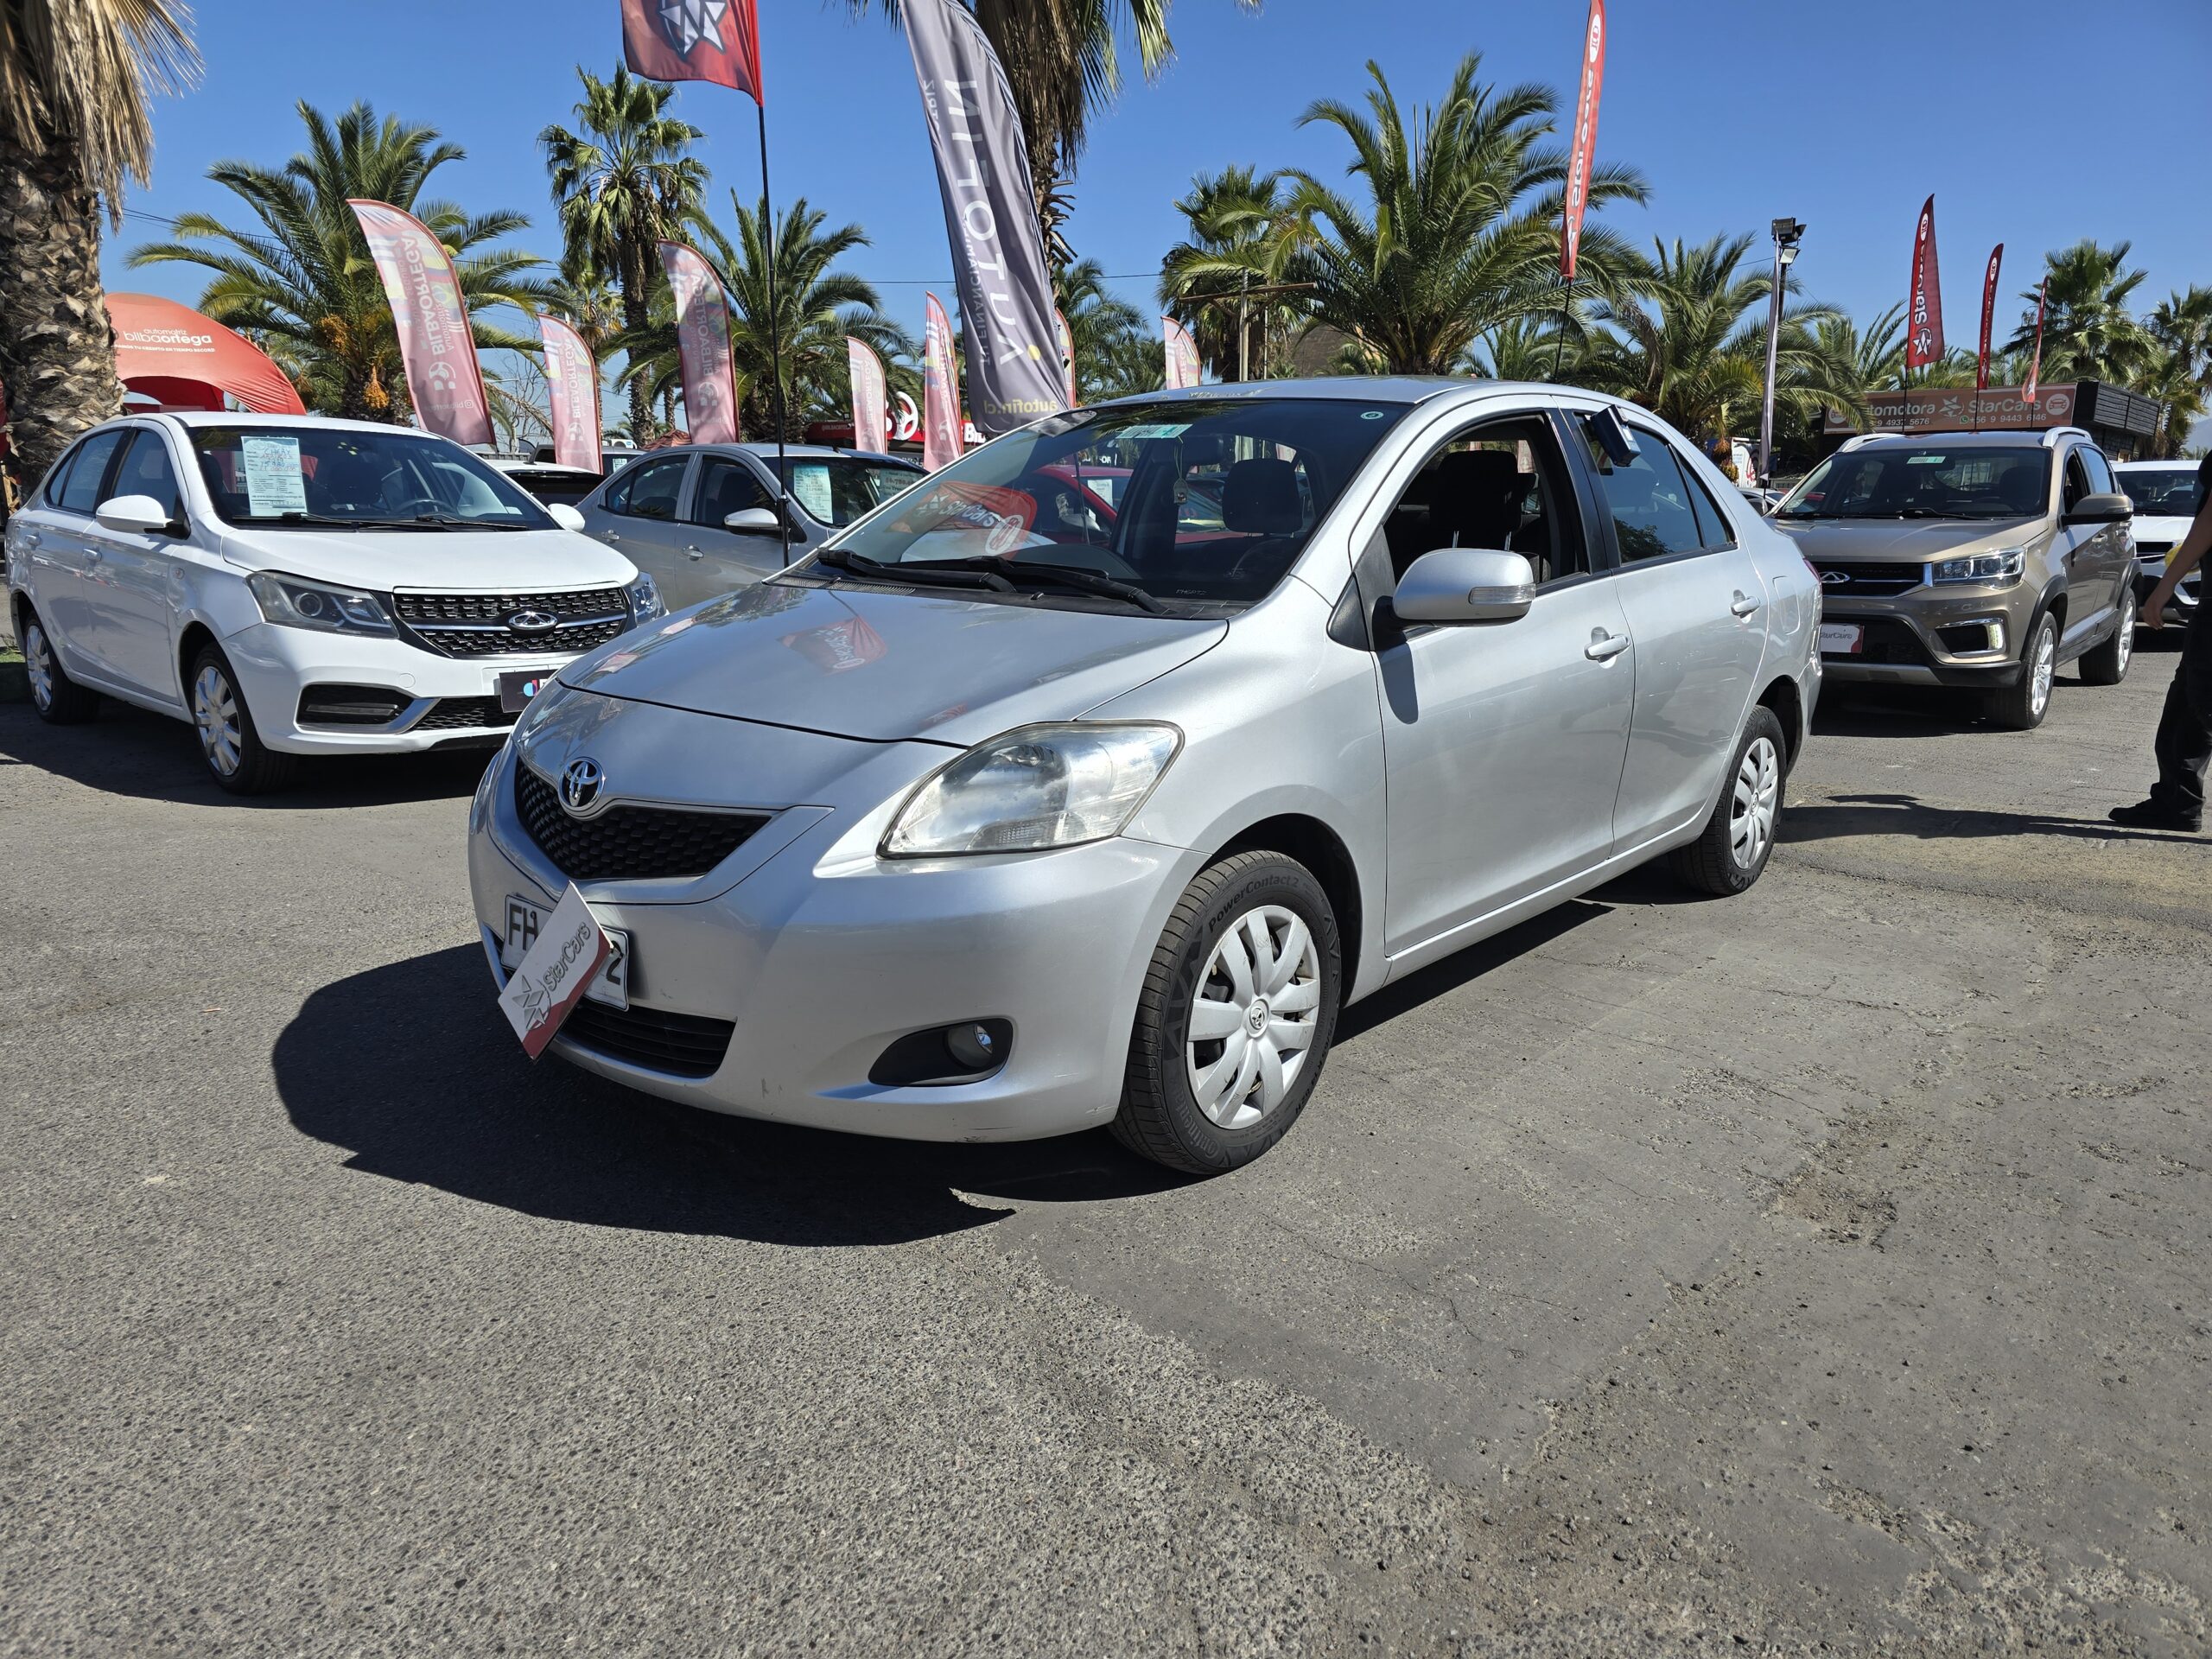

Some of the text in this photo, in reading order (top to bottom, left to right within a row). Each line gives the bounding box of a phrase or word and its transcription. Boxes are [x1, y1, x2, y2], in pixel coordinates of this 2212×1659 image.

[124, 332, 213, 346] bilbaortega
[1869, 398, 2042, 416] tomotora StarCars
[542, 921, 592, 992] StarCars
